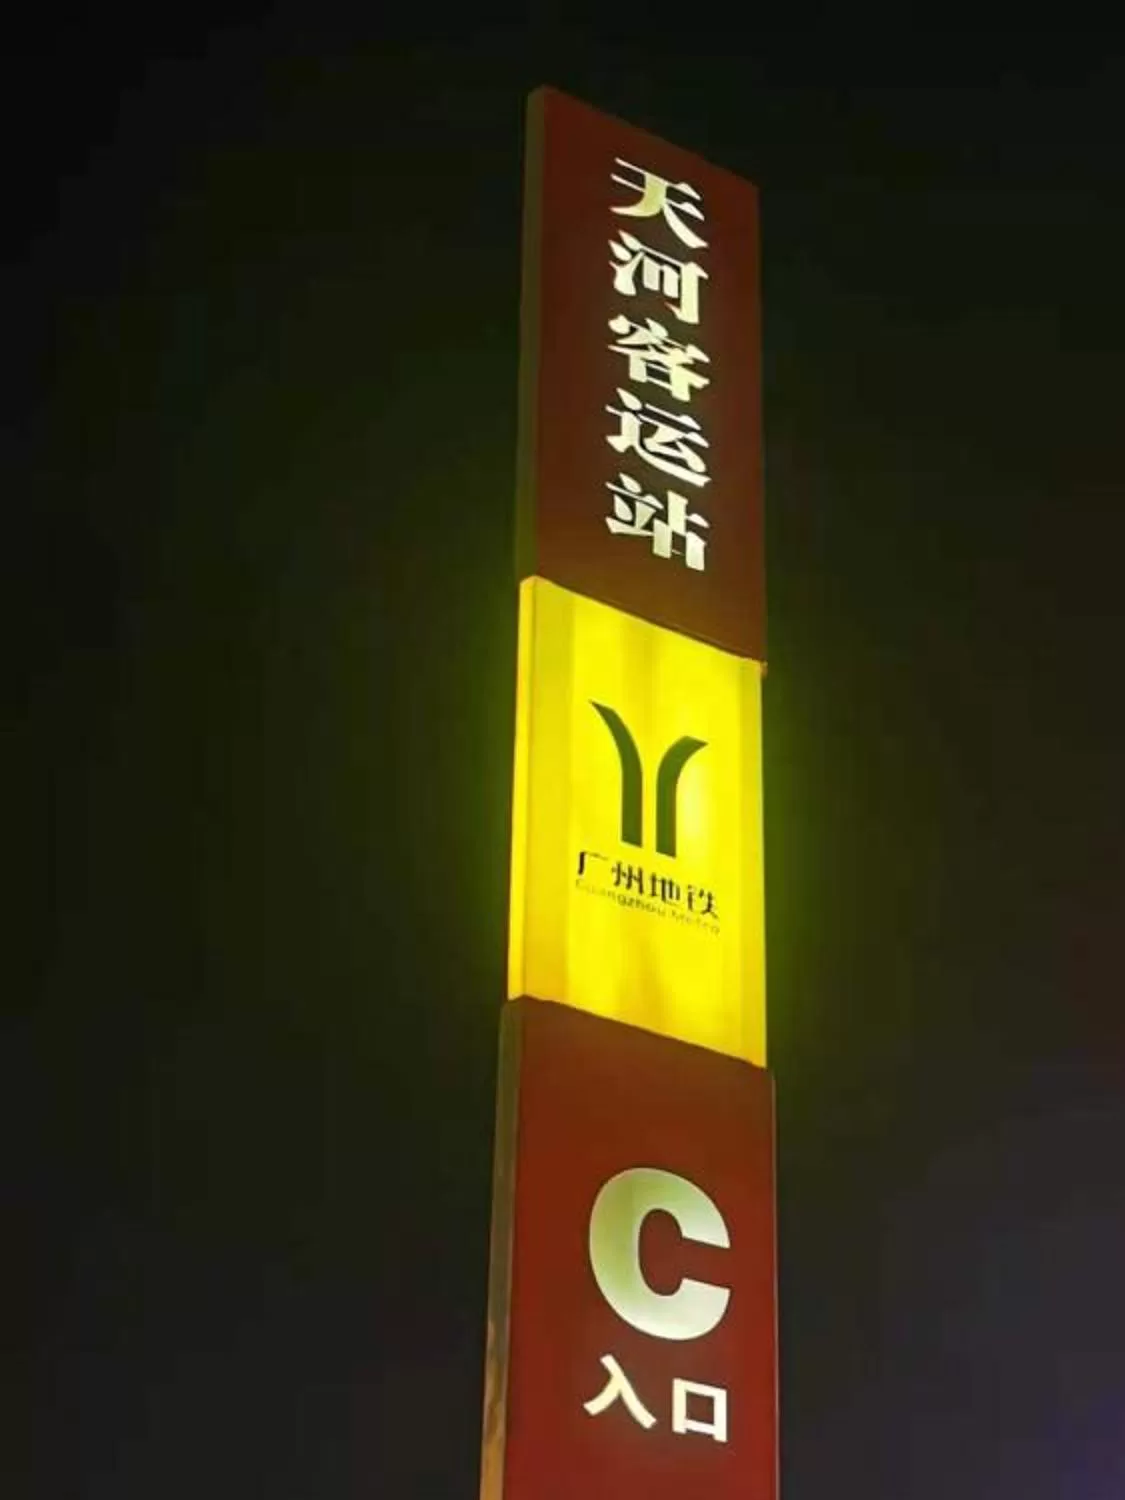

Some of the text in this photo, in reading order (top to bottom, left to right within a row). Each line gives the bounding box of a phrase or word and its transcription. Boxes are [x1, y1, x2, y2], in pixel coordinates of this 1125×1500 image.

[606, 157, 711, 571] 天河客运站
[577, 850, 720, 921] 广州地铁
[589, 1166, 731, 1341] C
[583, 1353, 728, 1443] 入口
